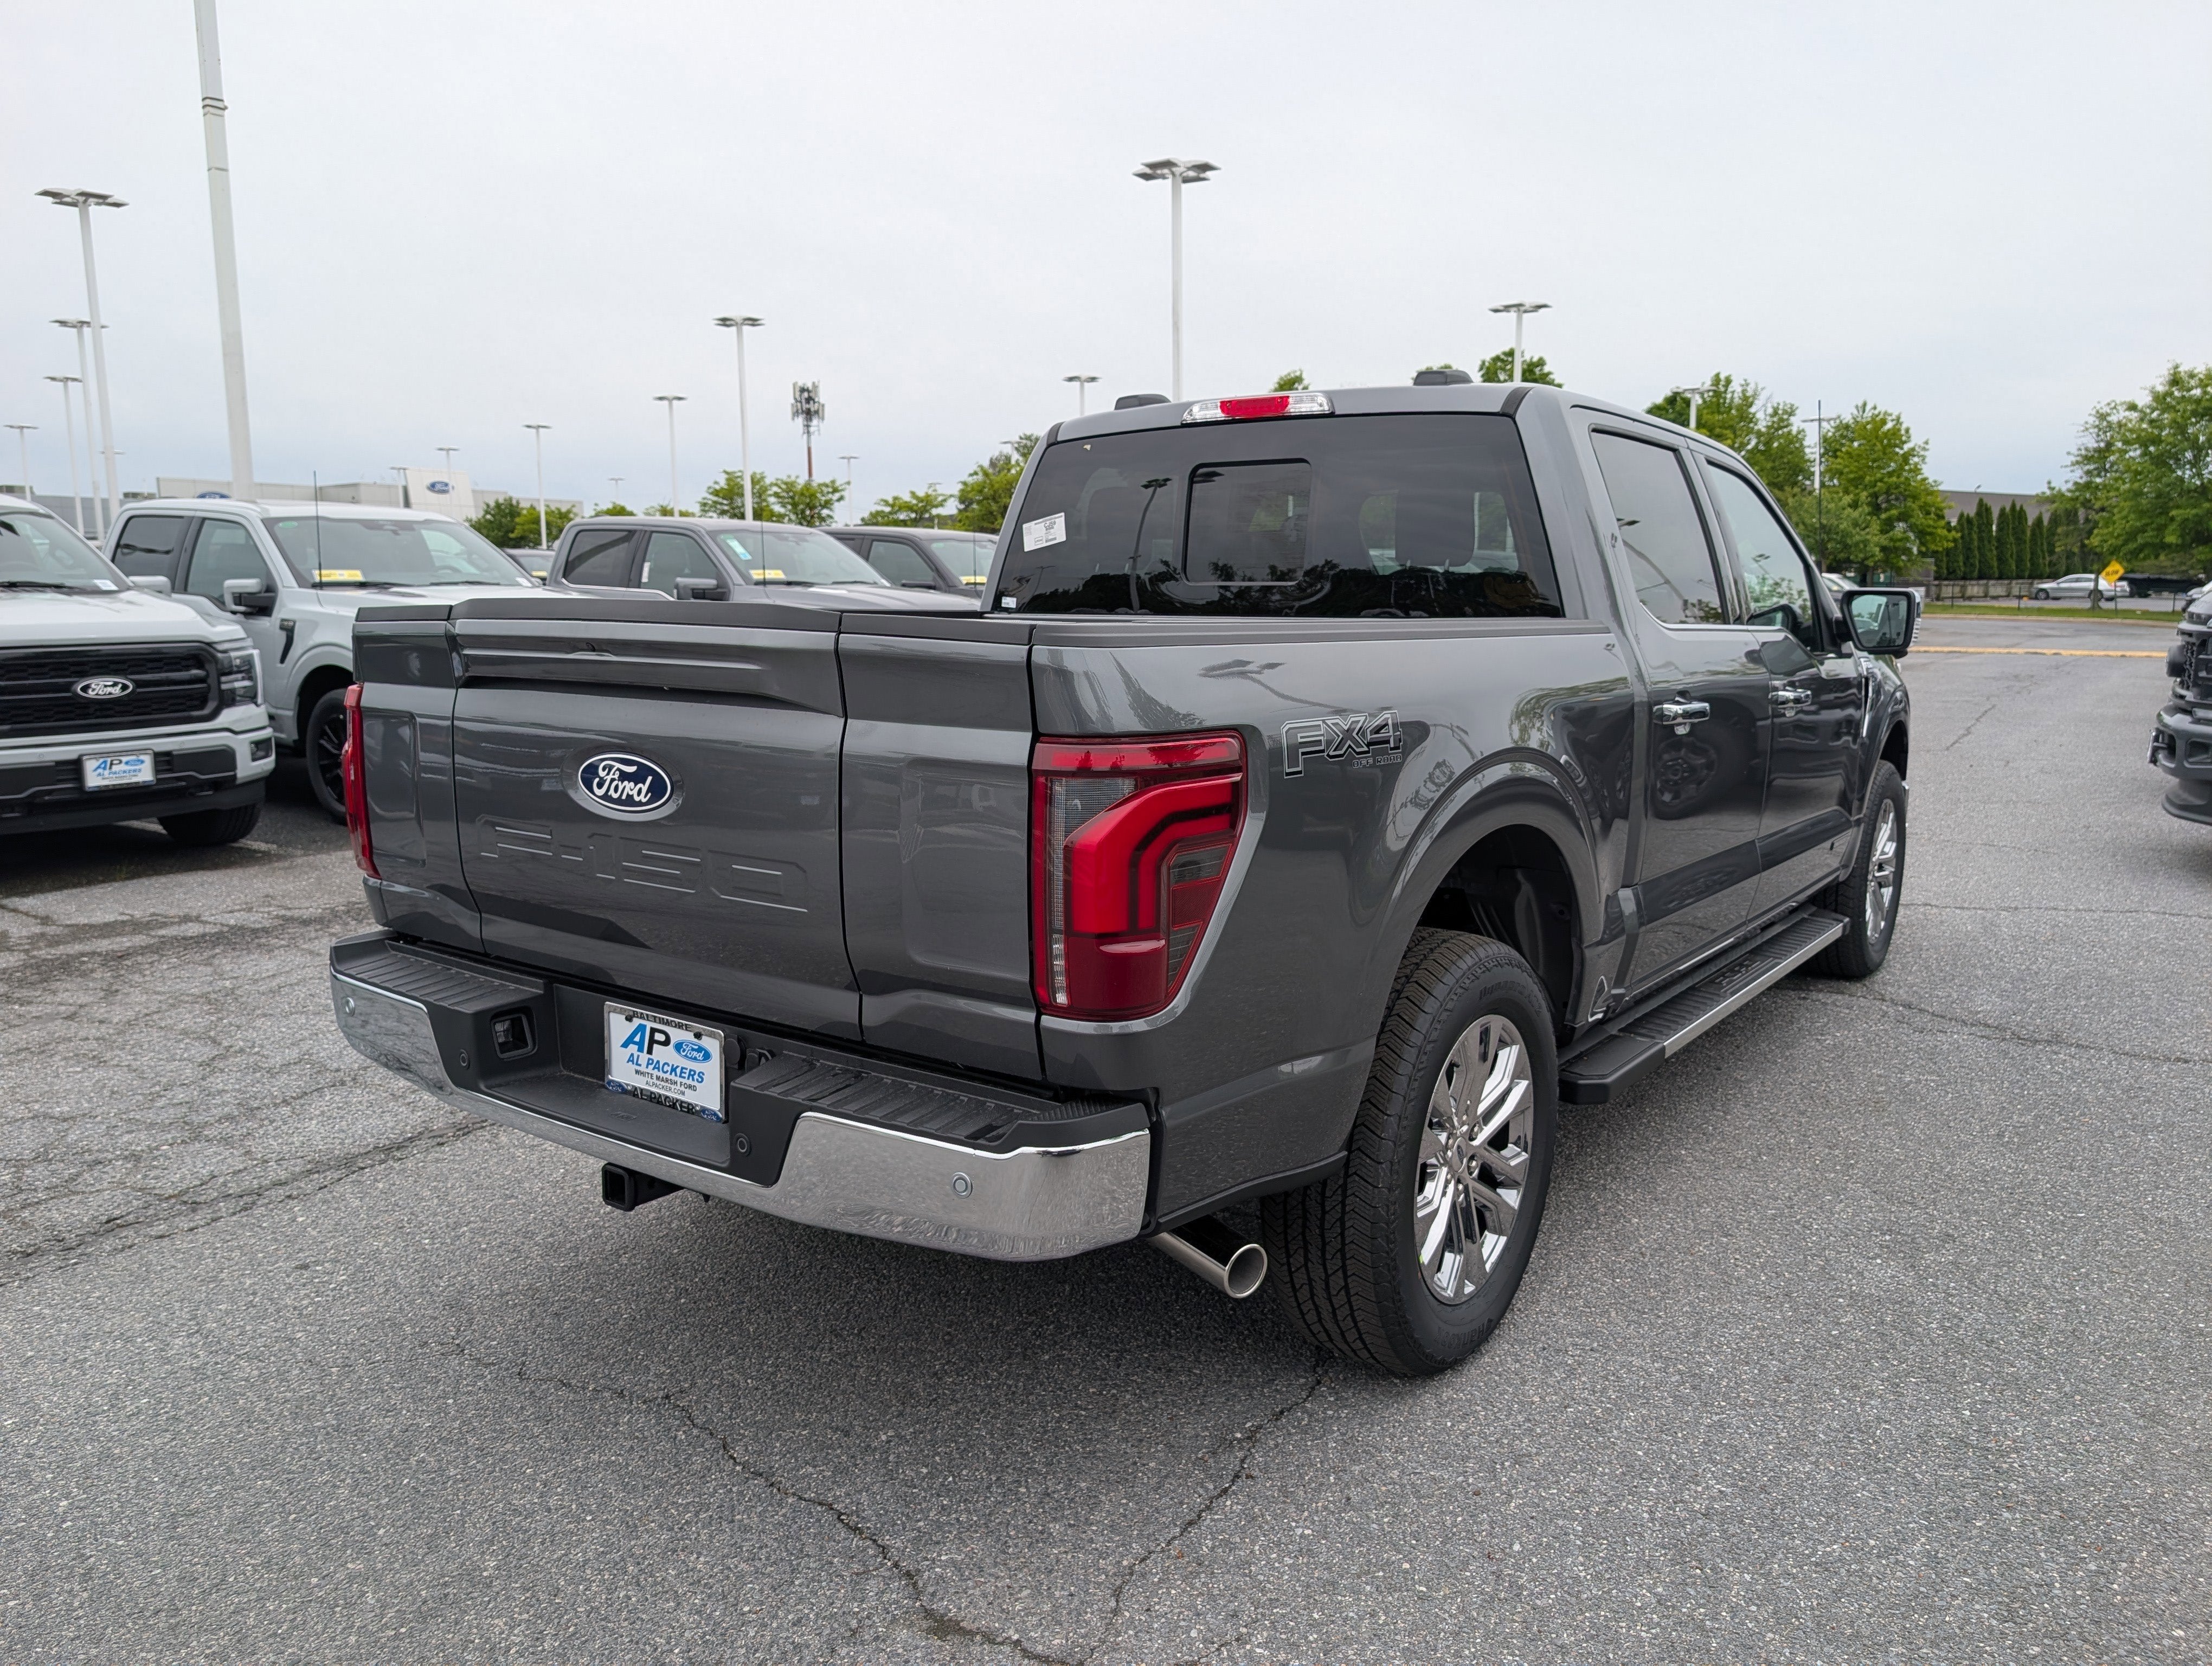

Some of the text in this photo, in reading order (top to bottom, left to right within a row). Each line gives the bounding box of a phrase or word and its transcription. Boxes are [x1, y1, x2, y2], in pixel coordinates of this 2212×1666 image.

[88, 681, 123, 695] Ford
[1281, 710, 1403, 779] FX4
[1352, 754, 1402, 768] OFF ROAD
[593, 760, 653, 802] Ford
[476, 814, 808, 912] F-150
[632, 1010, 692, 1030] BALTIMORE
[680, 1042, 704, 1061] Ford
[626, 1052, 705, 1084] AL PACKERS
[634, 1068, 697, 1092] WHITE MARSH FORD
[632, 1086, 695, 1114] AL PACKER
[645, 1080, 686, 1096] ALPACKER.COM
